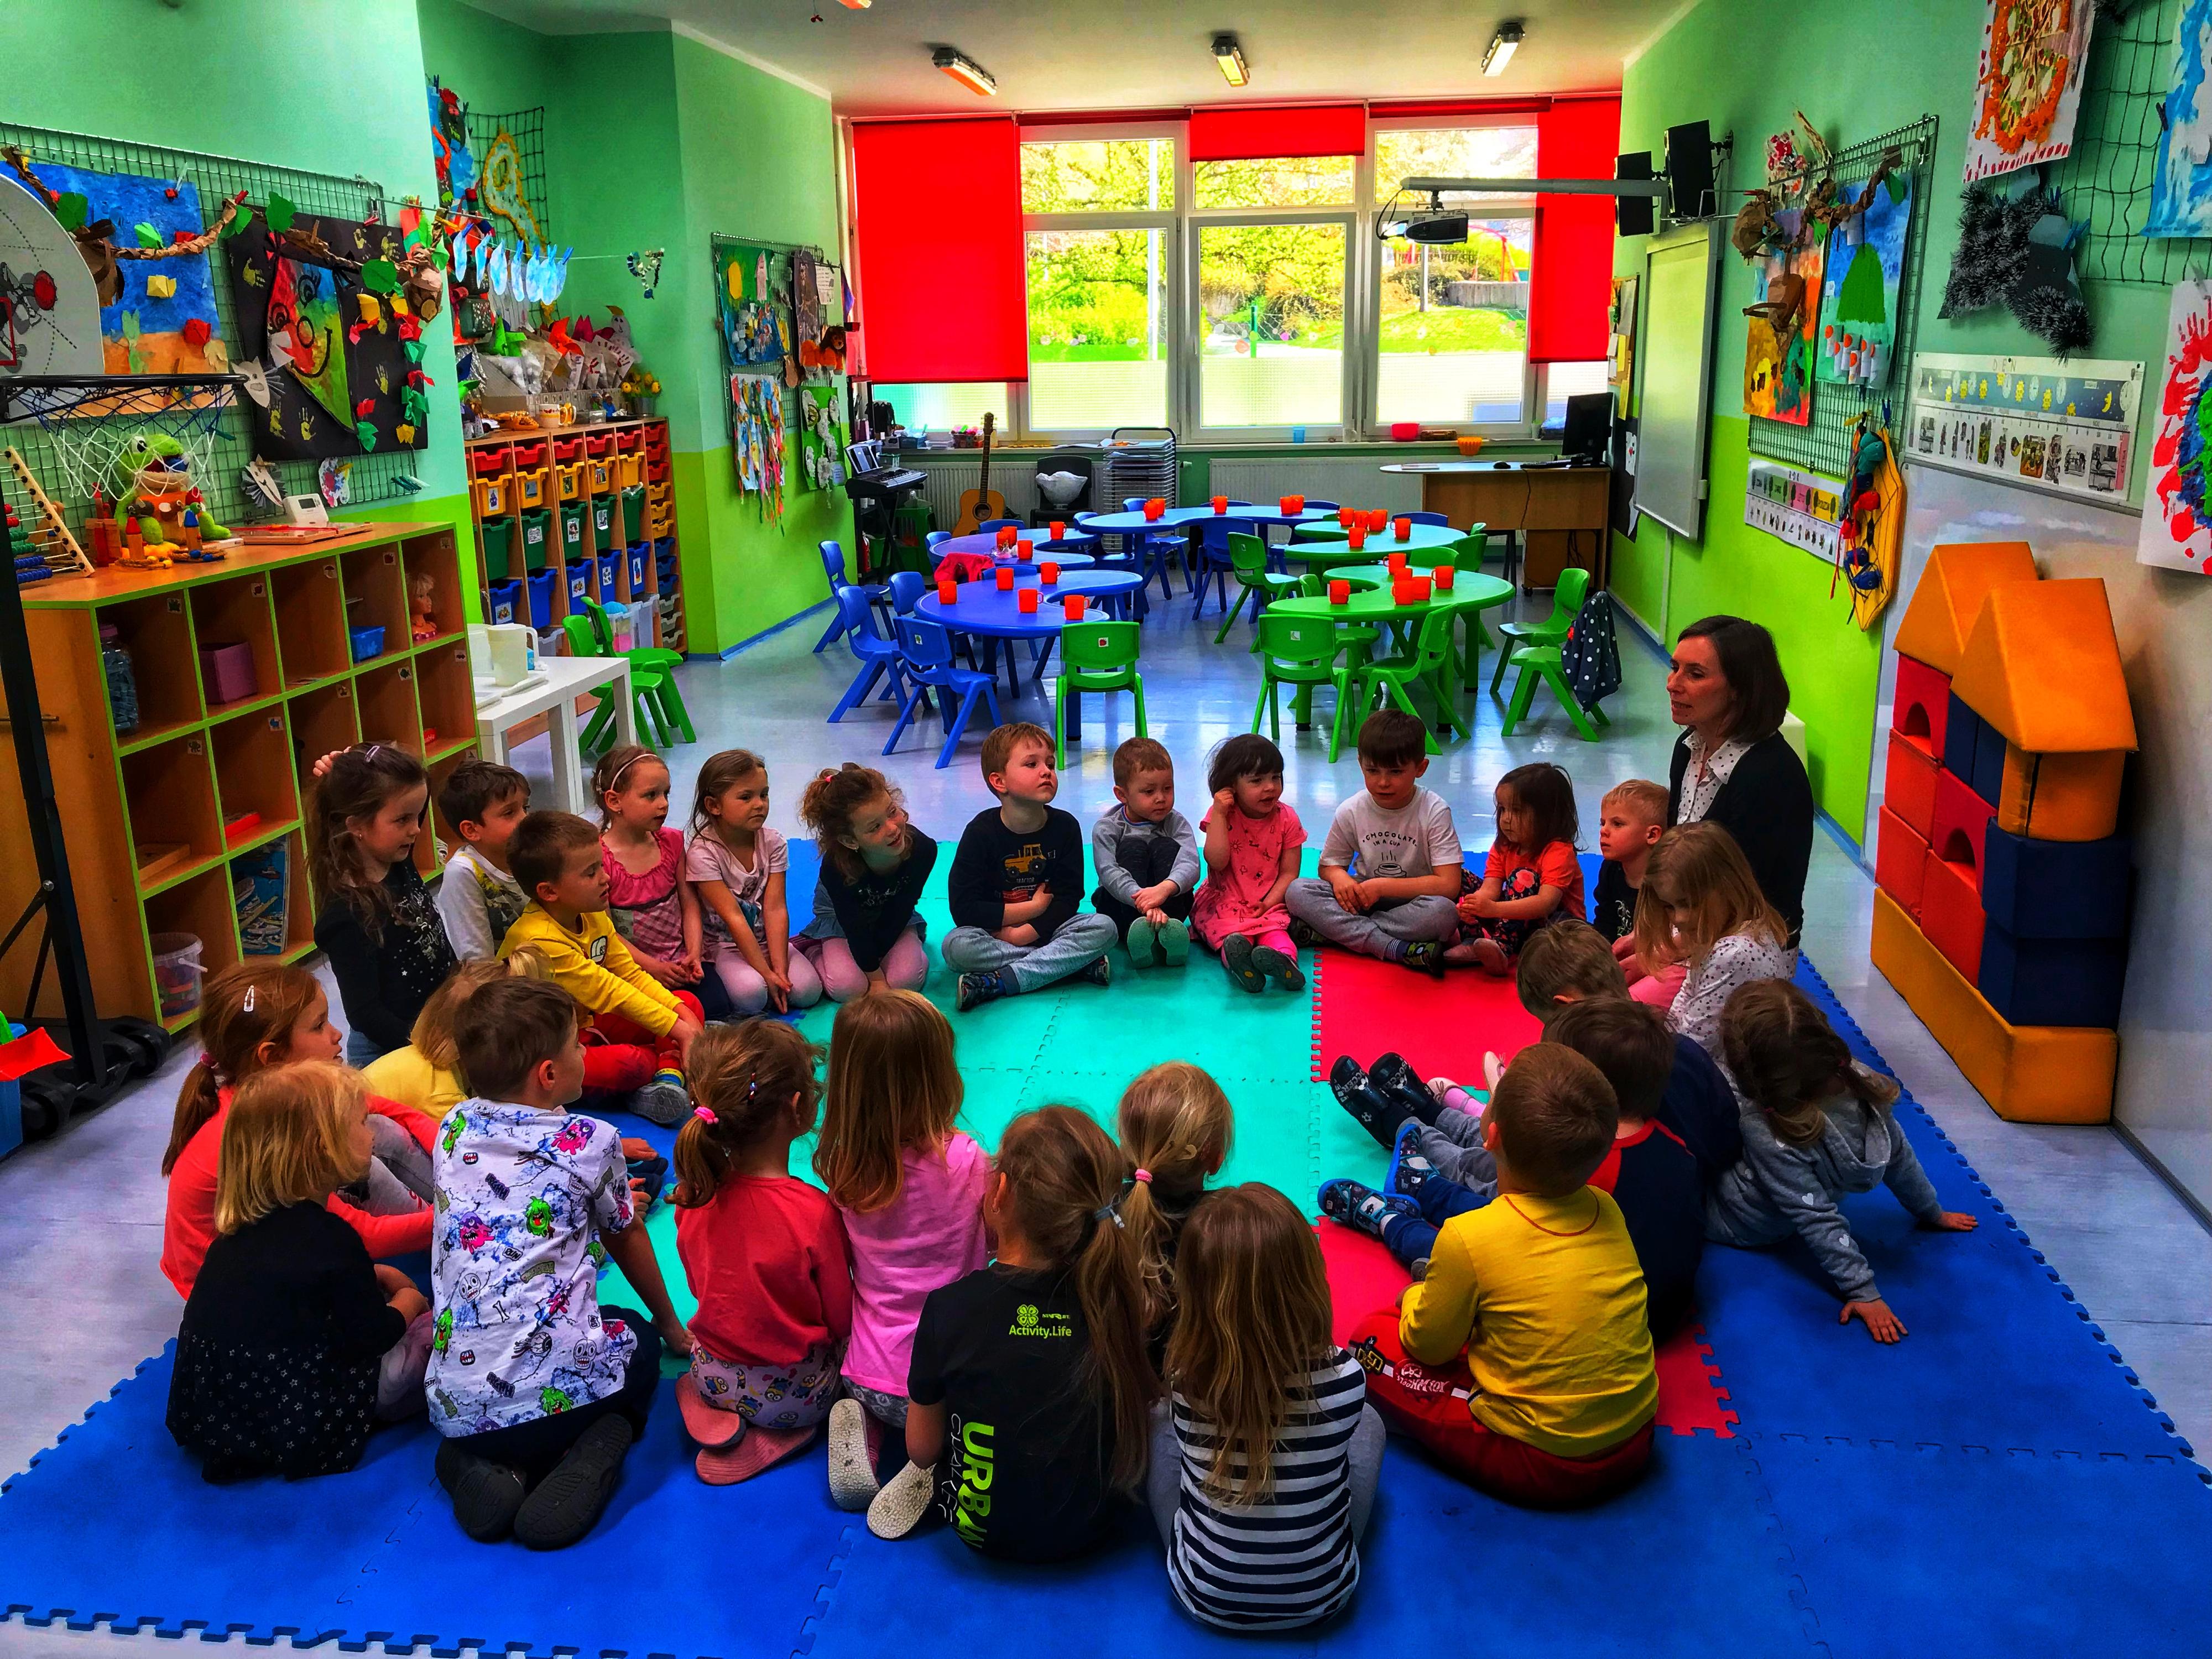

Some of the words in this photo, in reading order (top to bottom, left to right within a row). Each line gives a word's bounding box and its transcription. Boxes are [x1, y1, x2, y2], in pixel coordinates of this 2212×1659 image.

[1992, 359, 2017, 372] DEN
[1365, 831, 1416, 845] CHOCOLATE
[1342, 1068, 1366, 1093] OCCER
[504, 1247, 521, 1260] RUN
[1009, 1324, 1072, 1339] Activity.Life
